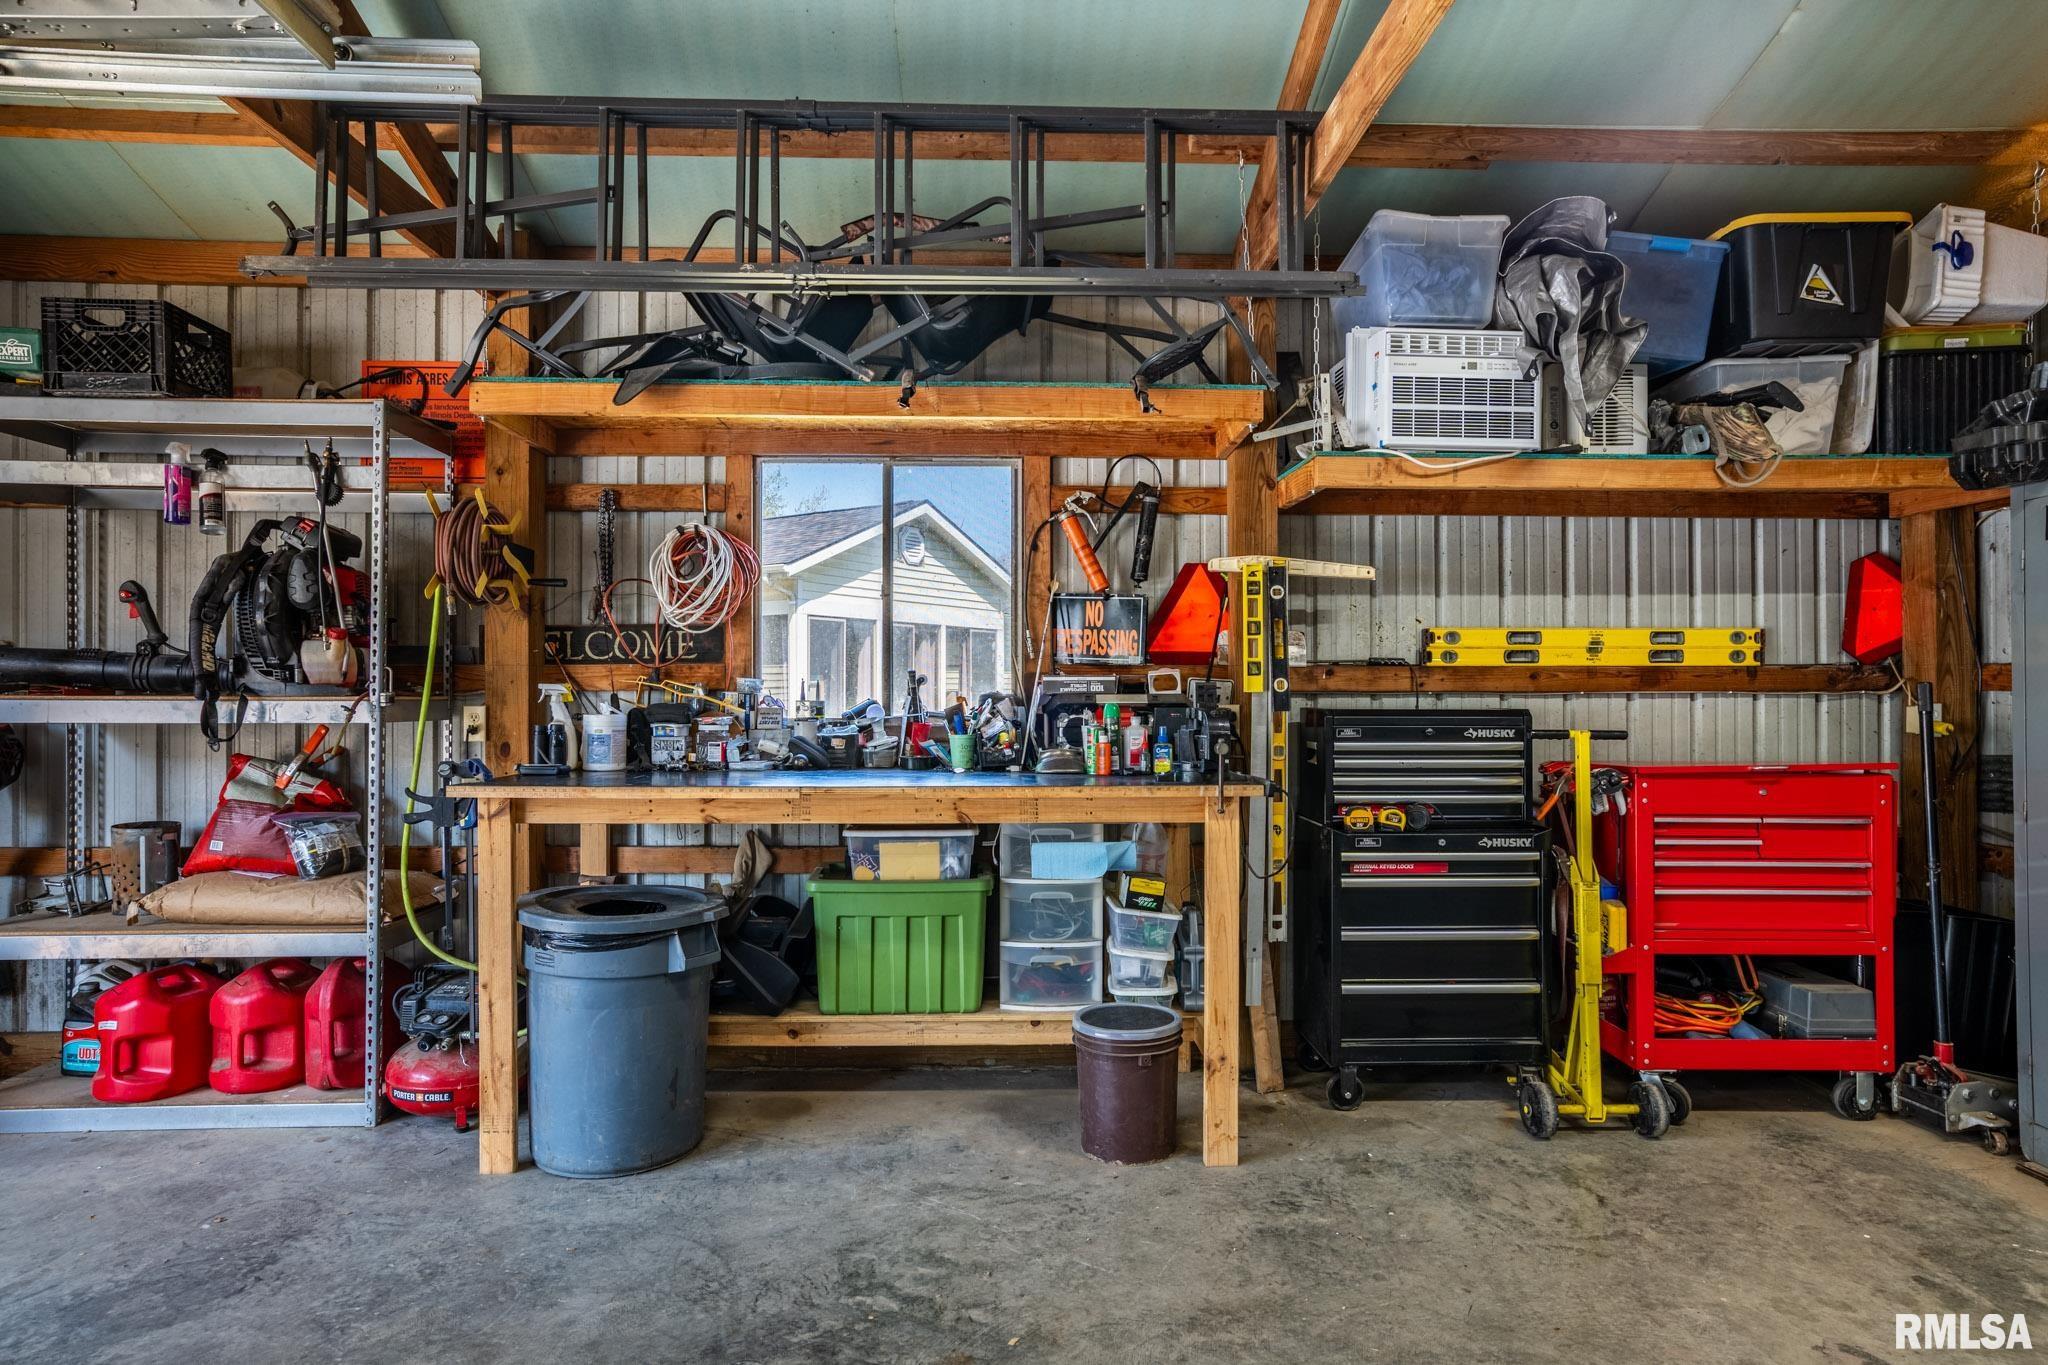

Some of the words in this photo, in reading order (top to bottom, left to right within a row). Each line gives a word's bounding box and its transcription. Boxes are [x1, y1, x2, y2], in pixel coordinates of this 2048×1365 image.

[1085, 600, 1104, 628] NO
[545, 630, 698, 660] ELCOME
[1477, 729, 1516, 737] HUSKY
[1492, 838, 1532, 847] HUSKY
[393, 1089, 415, 1101] PORTER
